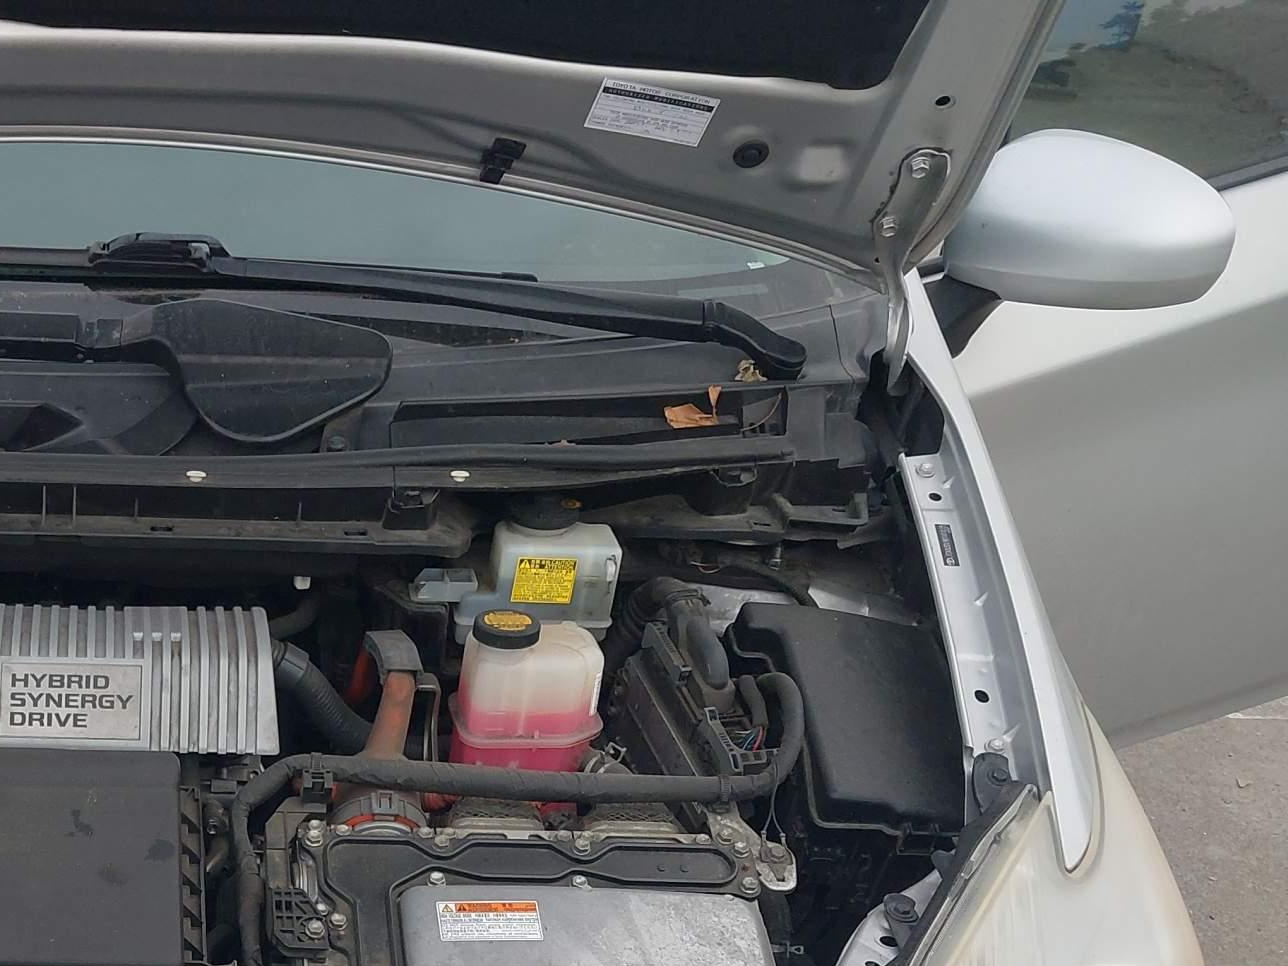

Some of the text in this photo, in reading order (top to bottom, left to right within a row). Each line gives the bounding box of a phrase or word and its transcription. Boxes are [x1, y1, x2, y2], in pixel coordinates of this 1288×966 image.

[612, 81, 711, 105] TOYOTA MOTOR CORPORATION
[11, 673, 110, 689] HYBRID
[10, 692, 134, 710] SYNERGY
[9, 711, 88, 728] DRIVE
